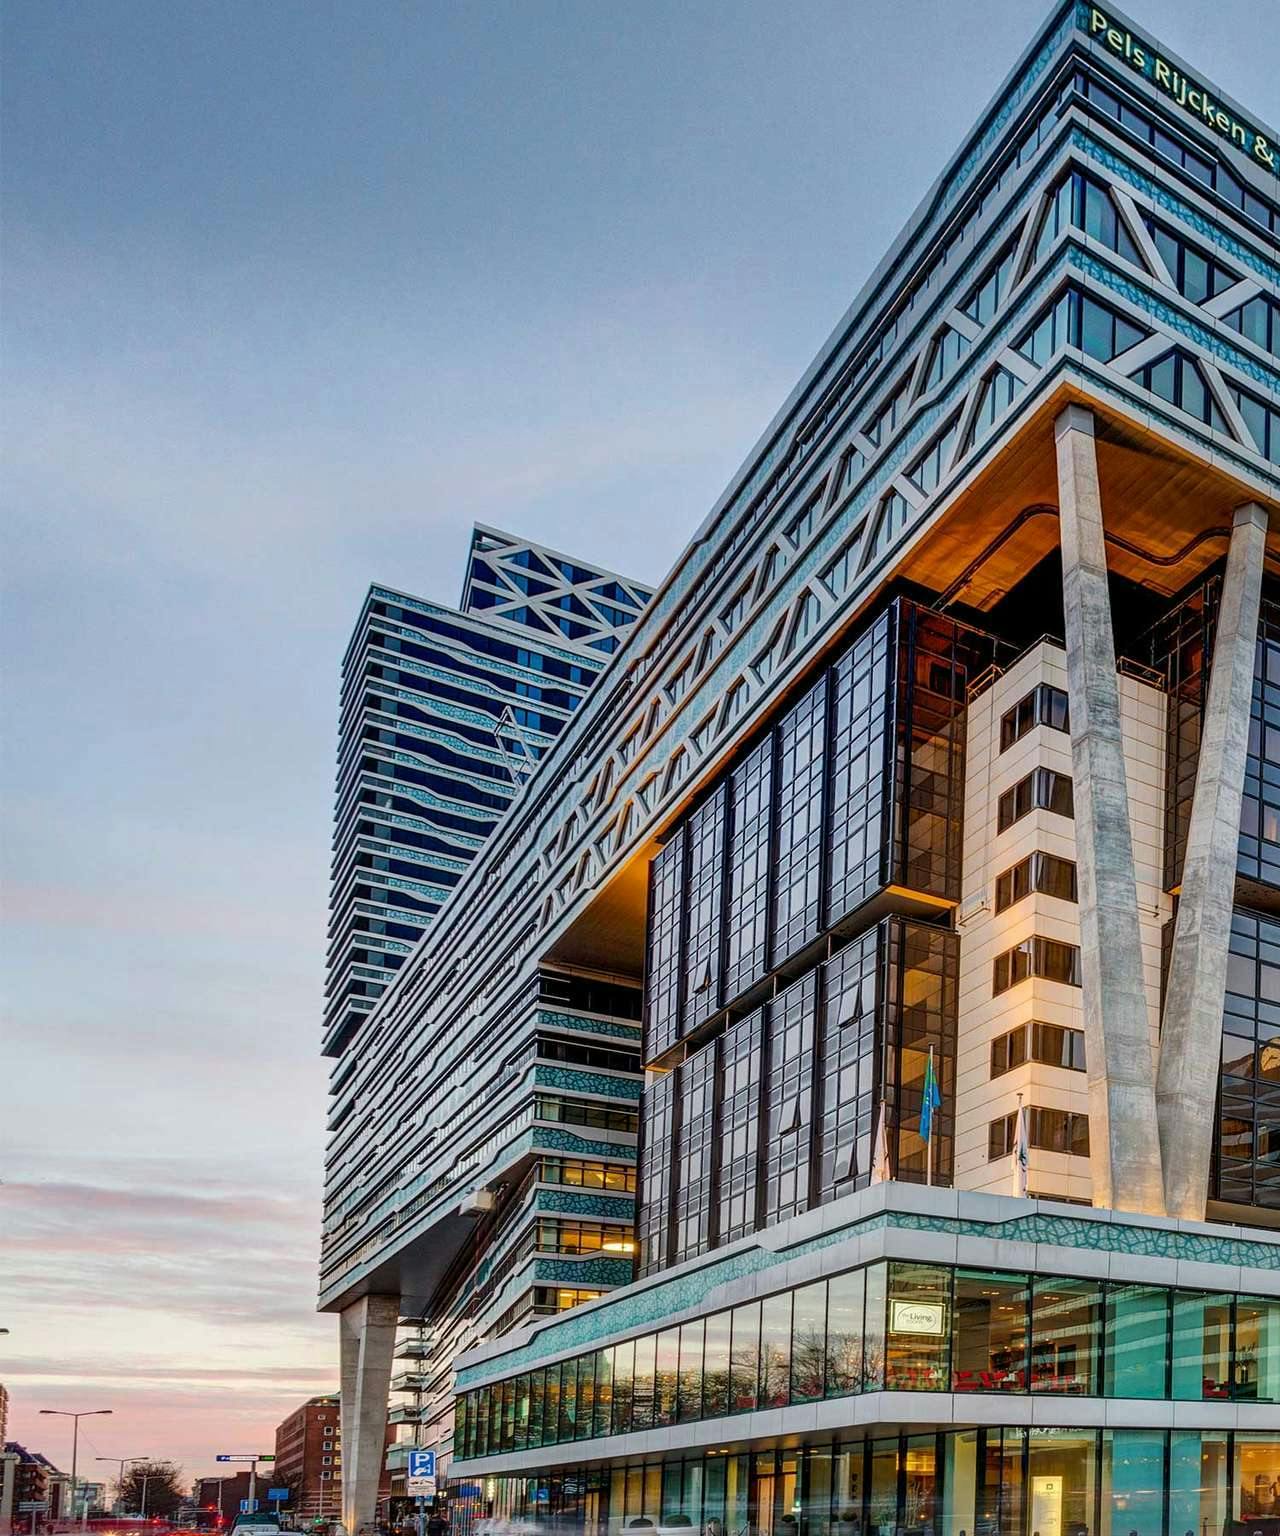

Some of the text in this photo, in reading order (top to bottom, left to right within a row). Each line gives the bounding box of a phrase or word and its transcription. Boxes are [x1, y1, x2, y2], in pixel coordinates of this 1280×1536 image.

[1092, 9, 1145, 67] Pels
[1155, 58, 1245, 145] Rijcken
[1254, 135, 1275, 167] &
[415, 1453, 430, 1467] P
